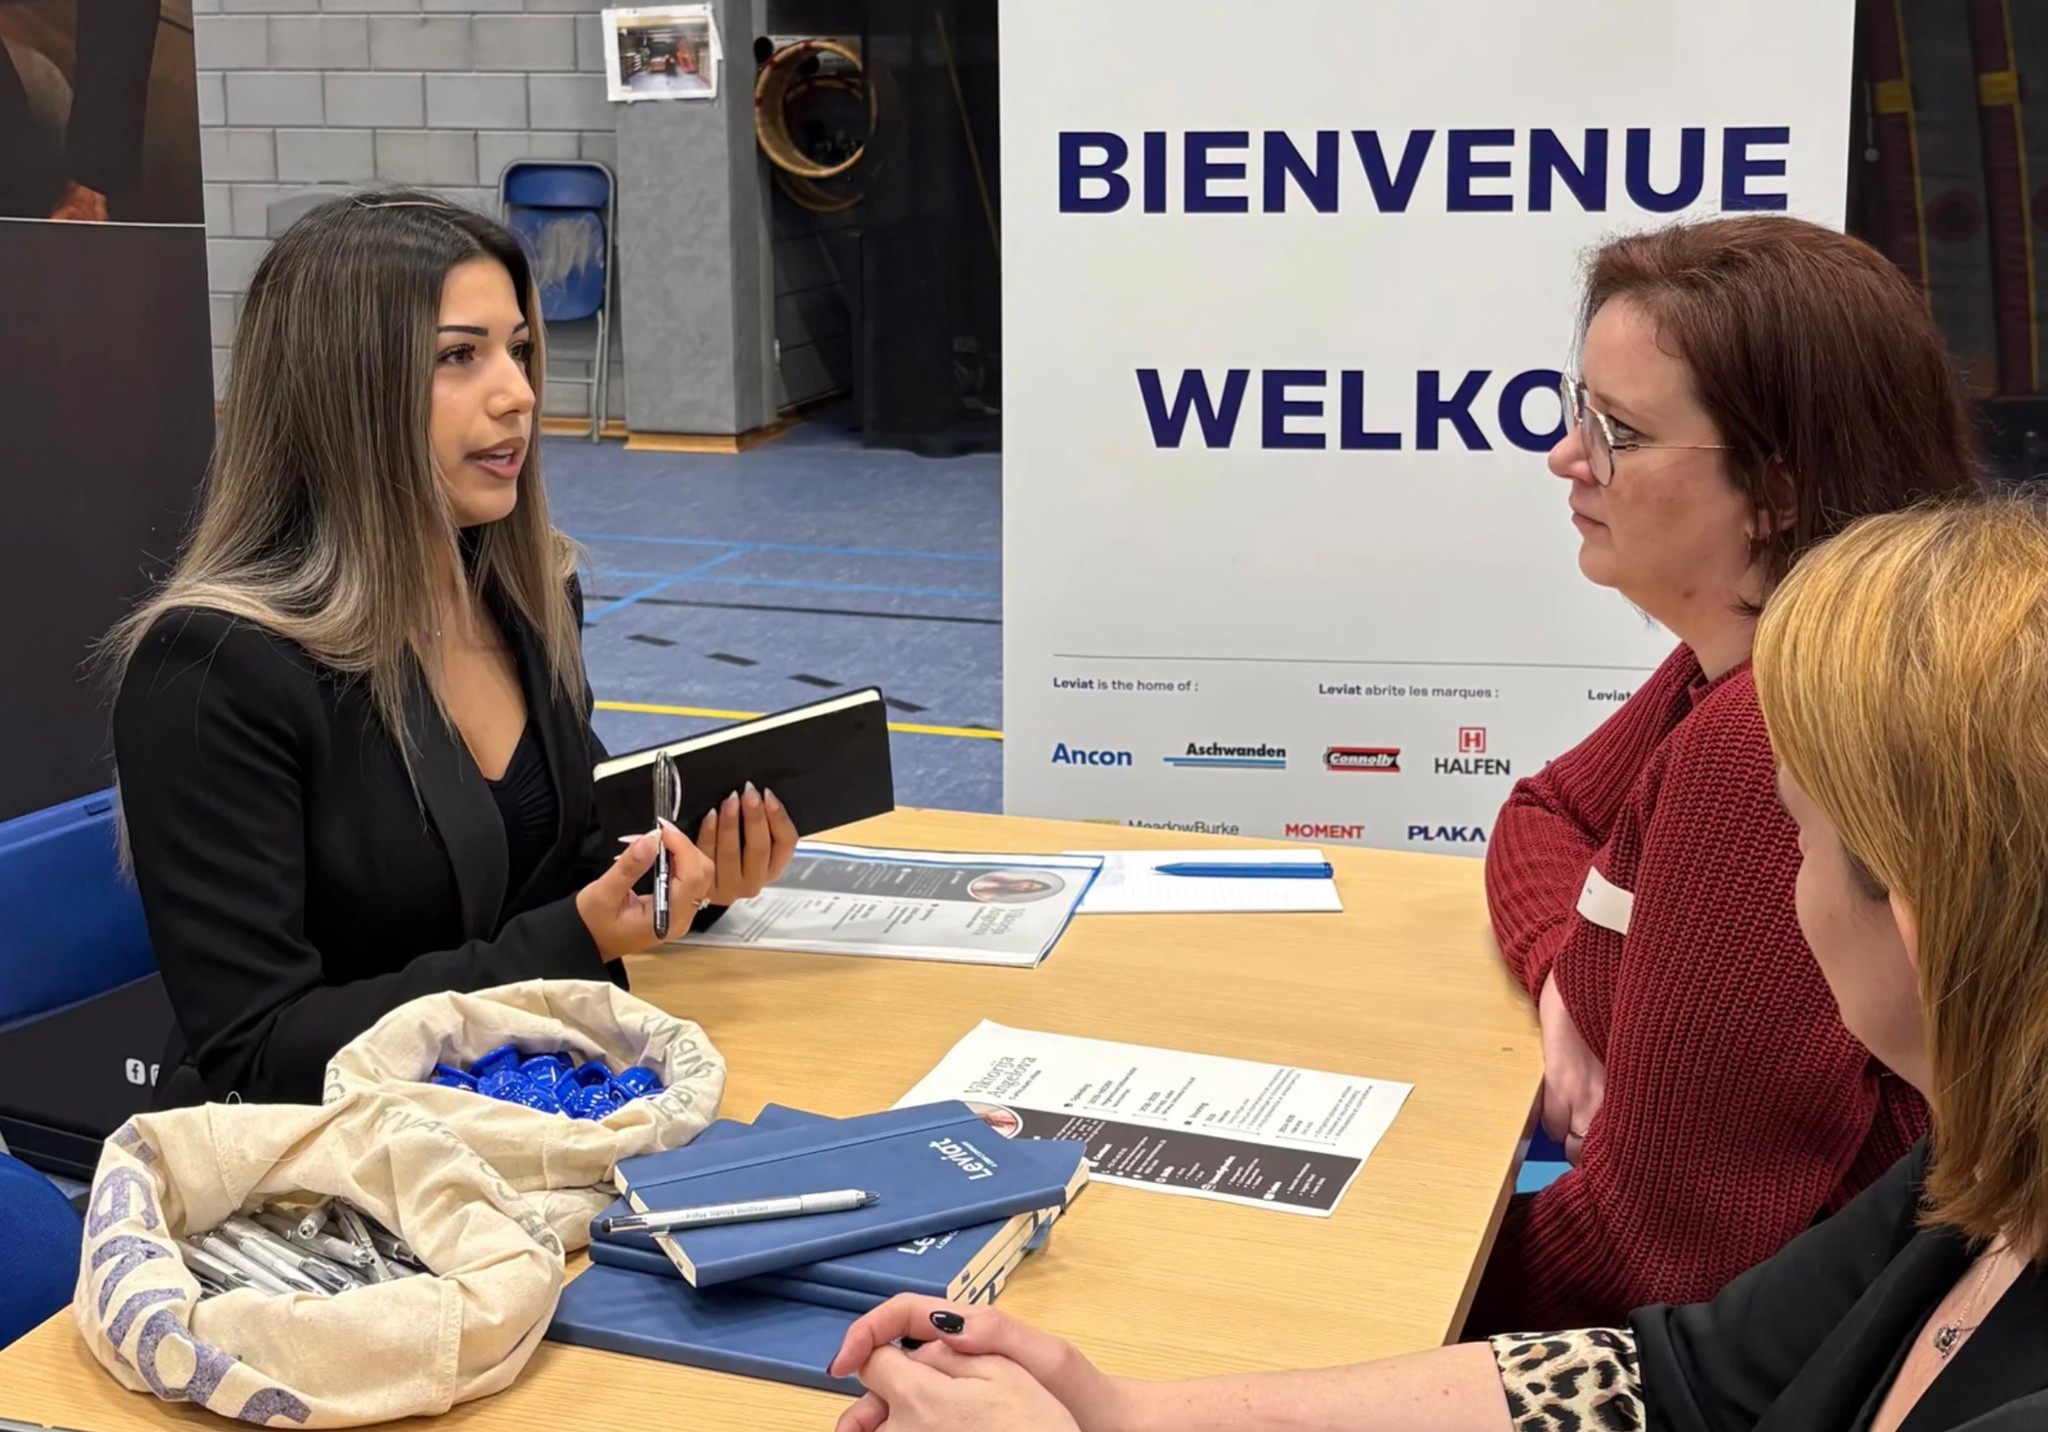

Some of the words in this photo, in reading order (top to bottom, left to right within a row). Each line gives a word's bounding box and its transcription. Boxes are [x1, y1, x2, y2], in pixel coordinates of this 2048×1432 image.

[1058, 126, 1790, 213] BIENVENUE
[1053, 677, 1094, 689] Leviat
[1098, 679, 1108, 690] is
[1112, 680, 1133, 691] the
[1137, 680, 1174, 692] home
[1178, 680, 1191, 692] of
[1319, 684, 1361, 695] Leviat
[1365, 685, 1405, 697] abrite
[1409, 685, 1428, 697] les
[1432, 687, 1491, 699] marques
[1051, 743, 1132, 766] Ancon
[1186, 742, 1286, 758] Aschwanden
[1329, 753, 1395, 767] Connolly
[1434, 758, 1510, 775] HALFEN
[1285, 824, 1364, 839] MOMENT
[1408, 826, 1486, 842] PLAKA
[964, 1056, 1015, 1093] Viktorija
[987, 1056, 1037, 1098] Angelova
[929, 1137, 994, 1180] Leviat
